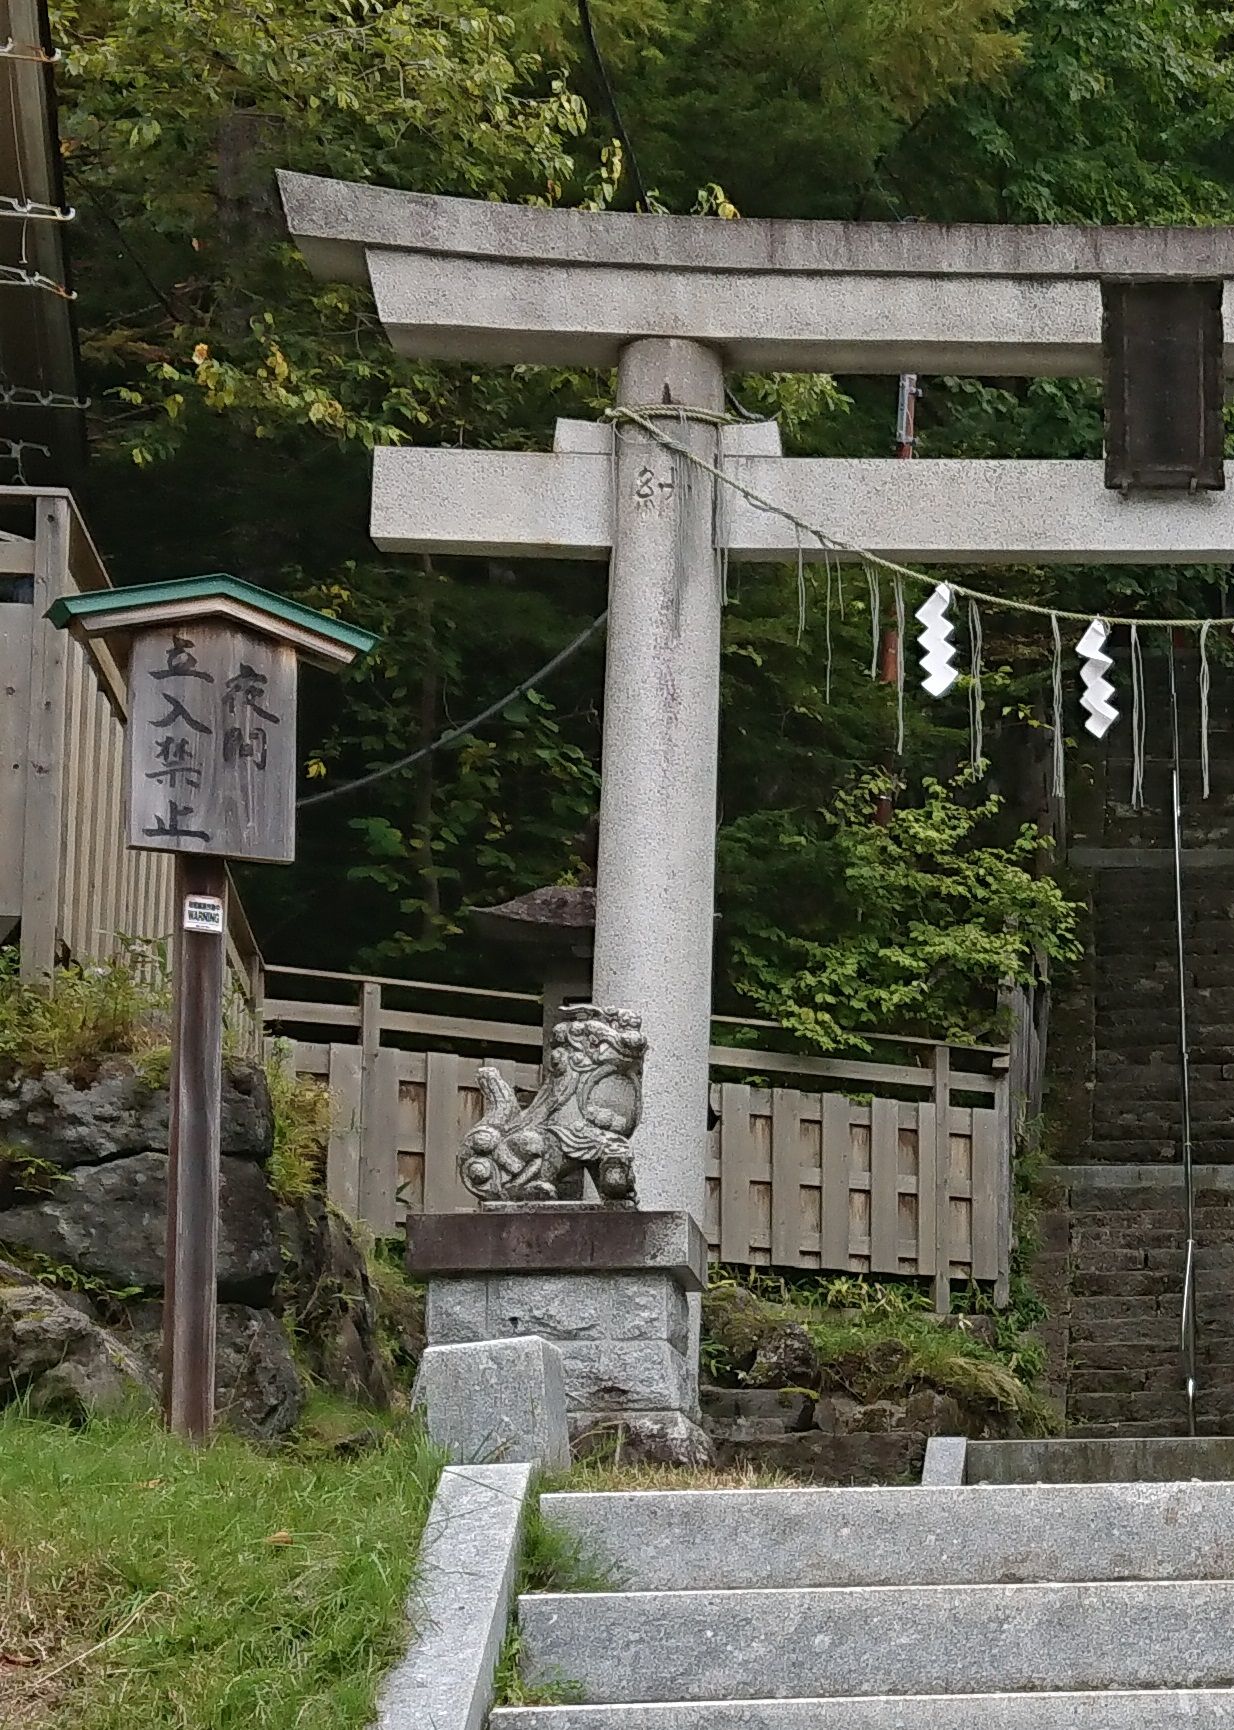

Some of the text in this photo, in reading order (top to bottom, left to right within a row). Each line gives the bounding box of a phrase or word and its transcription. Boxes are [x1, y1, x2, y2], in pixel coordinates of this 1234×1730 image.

[142, 634, 215, 843] 立入禁止
[221, 662, 281, 770] 夜間
[188, 910, 219, 923] WARNING
